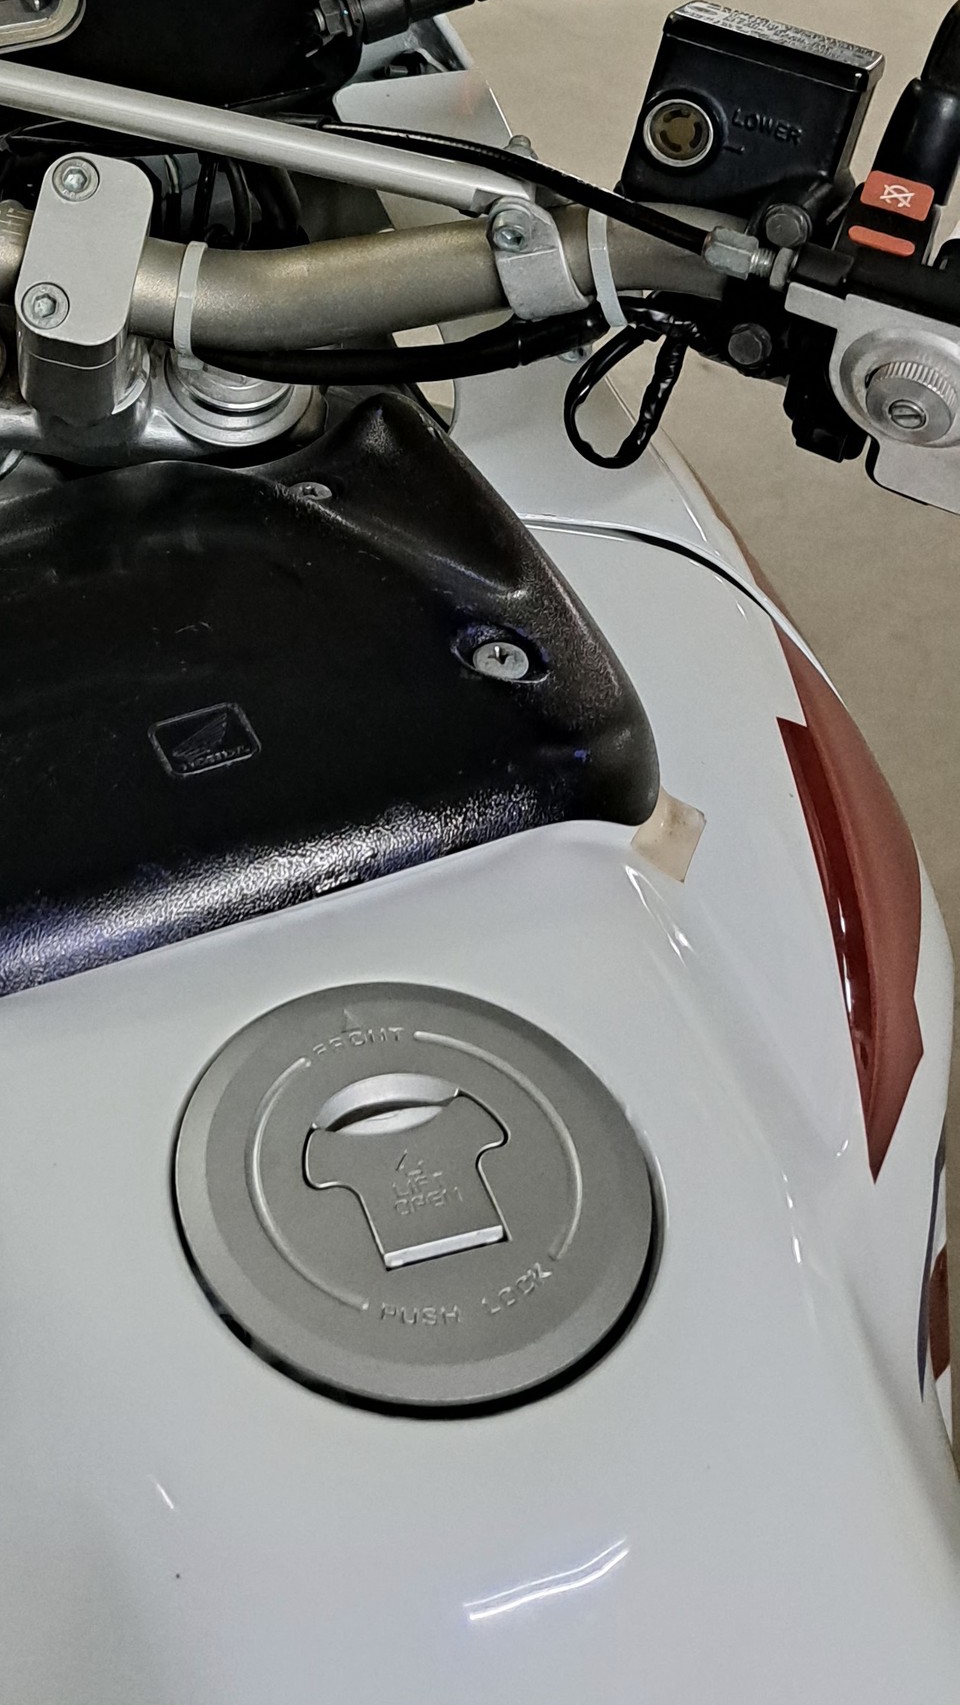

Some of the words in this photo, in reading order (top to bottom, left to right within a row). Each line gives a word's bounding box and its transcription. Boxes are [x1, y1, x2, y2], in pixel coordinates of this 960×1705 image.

[731, 108, 803, 145] LOWER
[312, 1027, 404, 1054] FRONT
[381, 1301, 461, 1325] PUSH
[481, 1262, 553, 1314] LOCK
